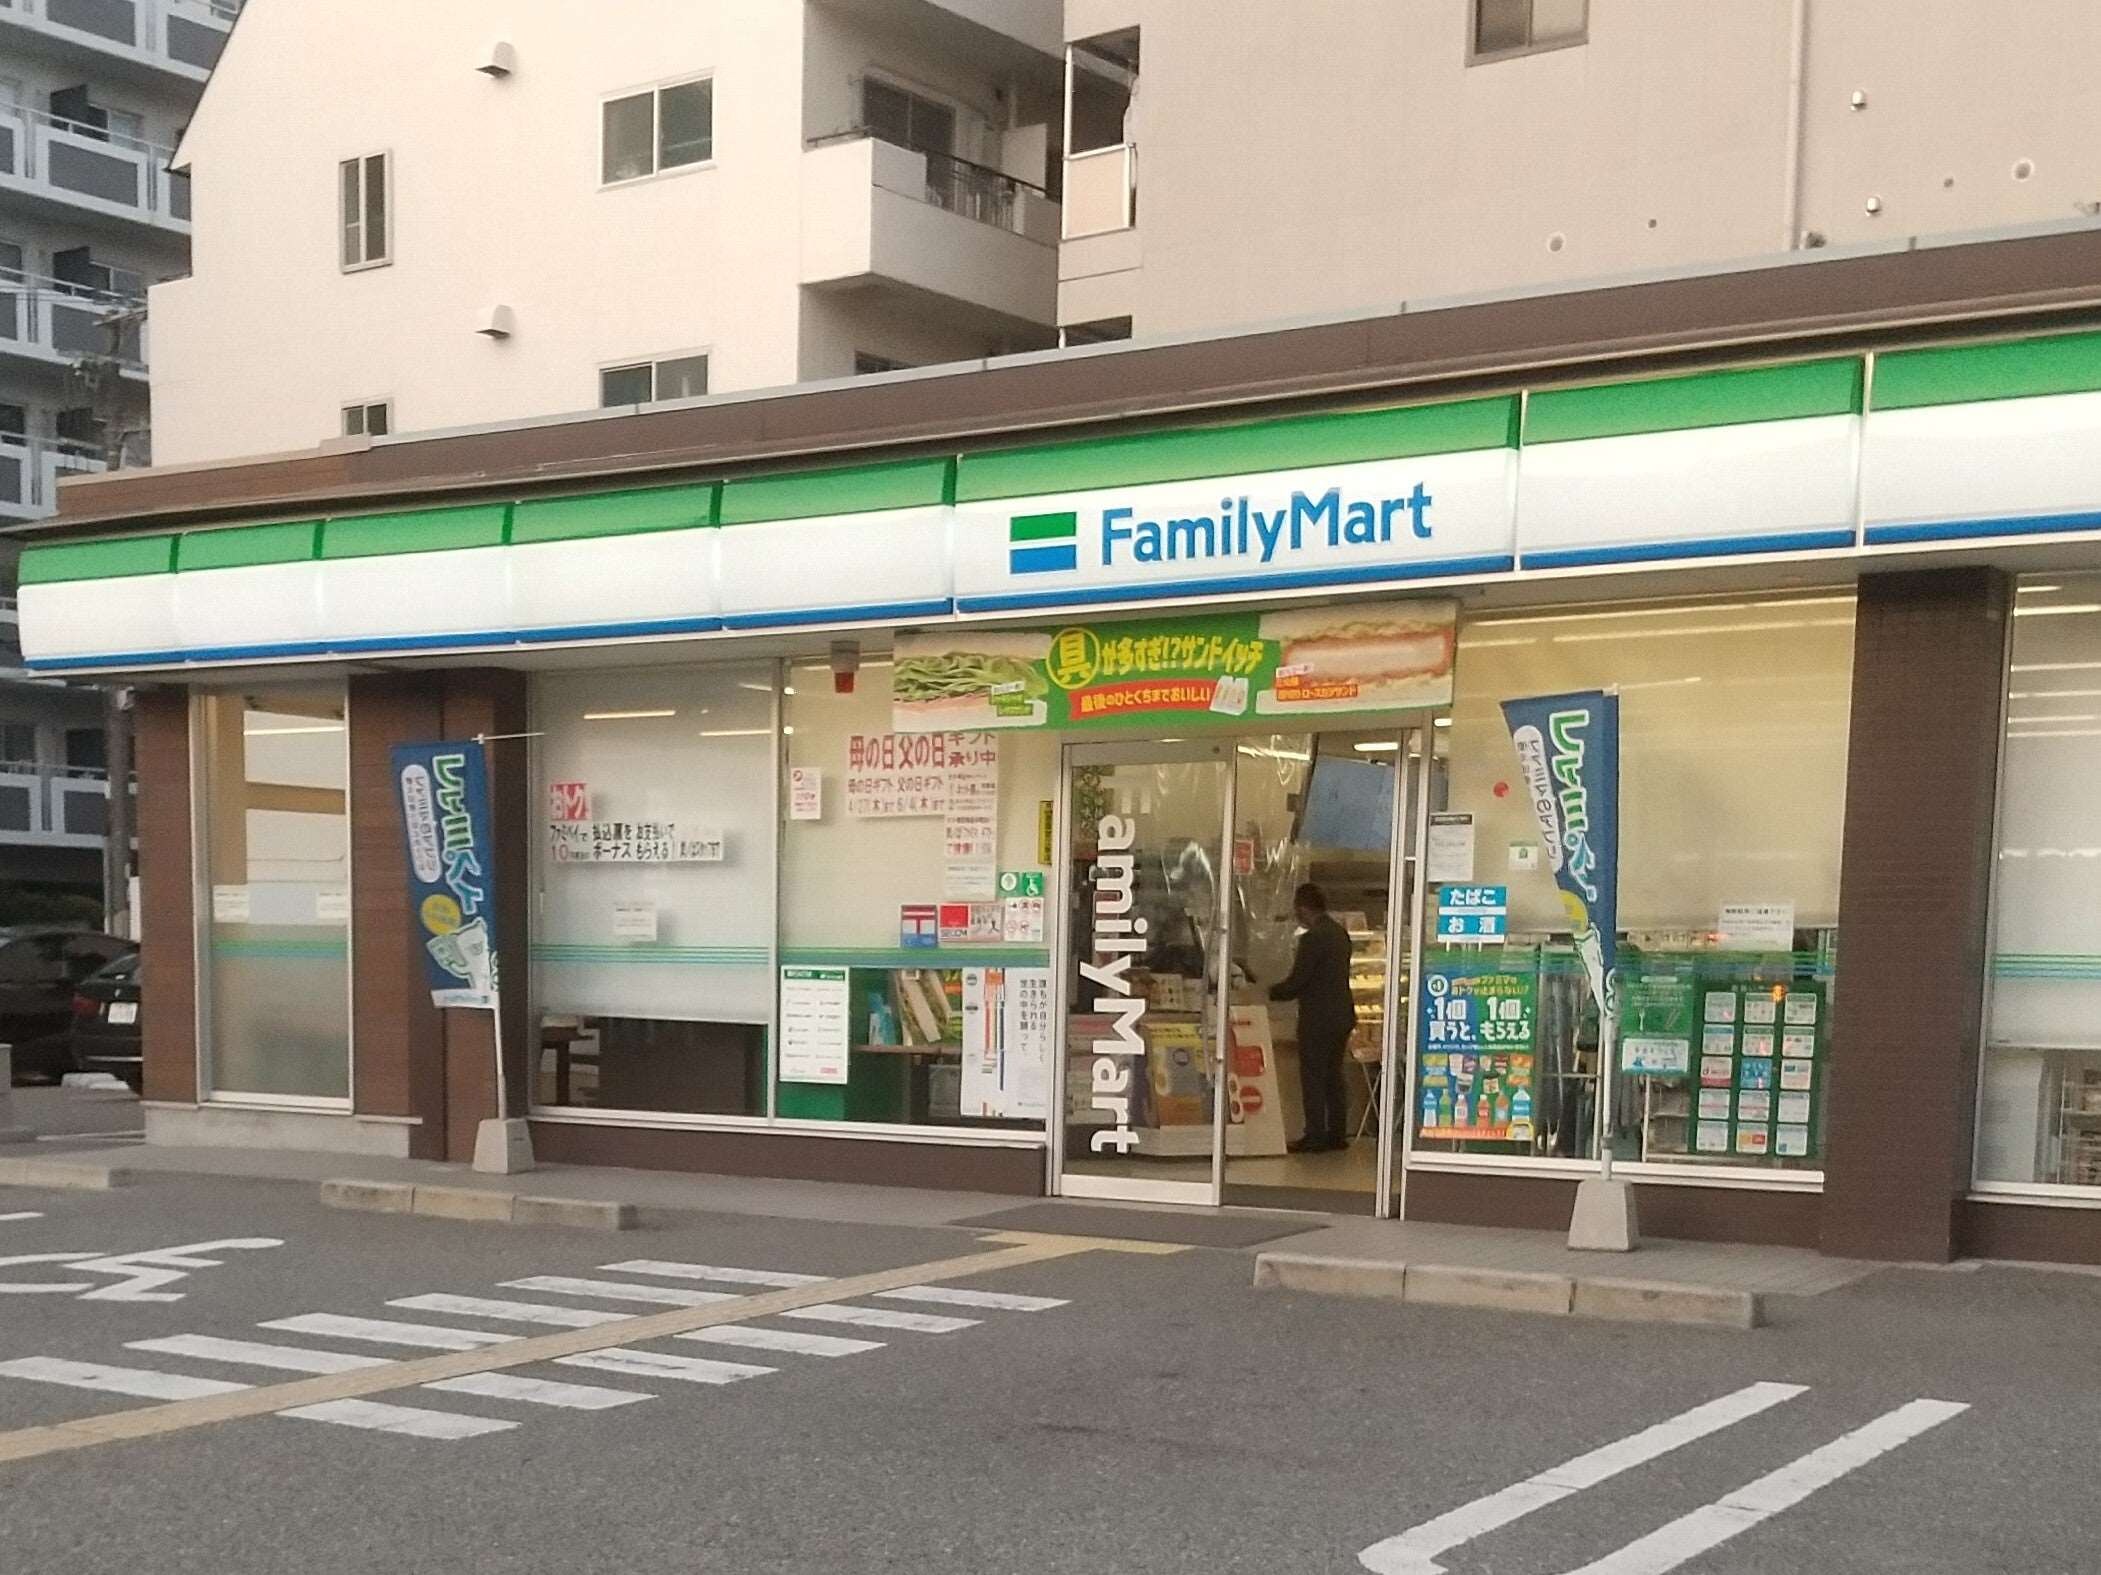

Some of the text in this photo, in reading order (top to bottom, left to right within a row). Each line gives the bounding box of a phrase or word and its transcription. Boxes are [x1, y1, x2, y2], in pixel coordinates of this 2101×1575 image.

[1102, 482, 1432, 566] FamilyMart
[1057, 632, 1092, 683] 具
[1450, 888, 1496, 905] たばこ
[1080, 774, 1150, 1154] FamilyMart
[1434, 997, 1467, 1021] 1個
[1487, 996, 1521, 1021] 1個
[1480, 1020, 1531, 1041] もらえる
